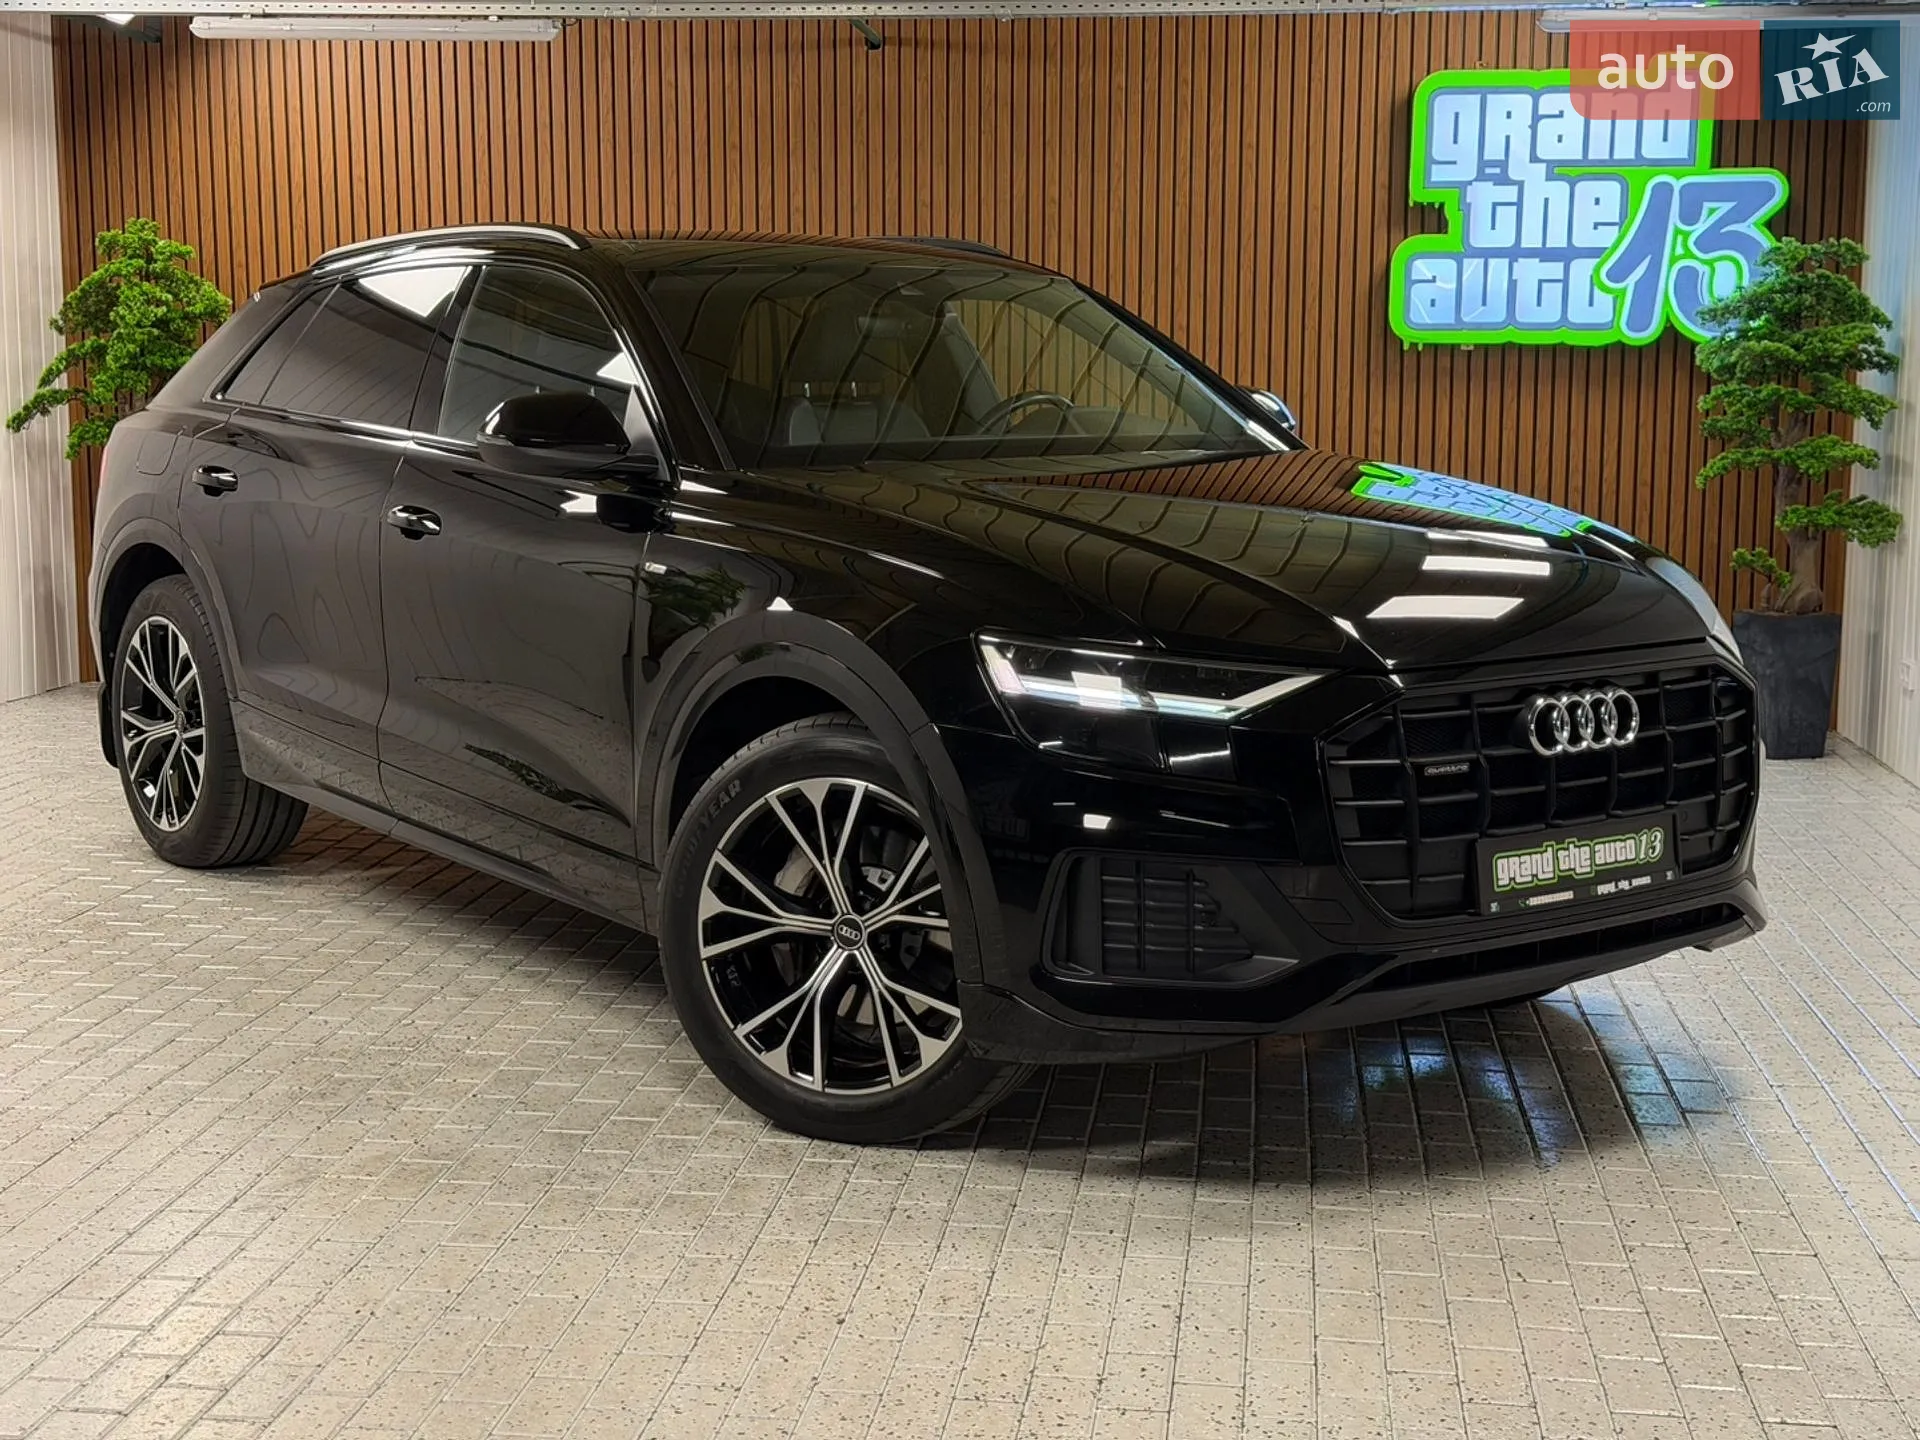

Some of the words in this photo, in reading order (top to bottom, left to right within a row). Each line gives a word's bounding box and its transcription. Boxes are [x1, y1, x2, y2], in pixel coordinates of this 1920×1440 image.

[1466, 172, 1622, 249] the
[1408, 258, 1616, 325] auto
[1602, 175, 1786, 339] 13
[1496, 846, 1555, 886] grand
[1557, 843, 1592, 874] the
[1638, 830, 1662, 860] 13
